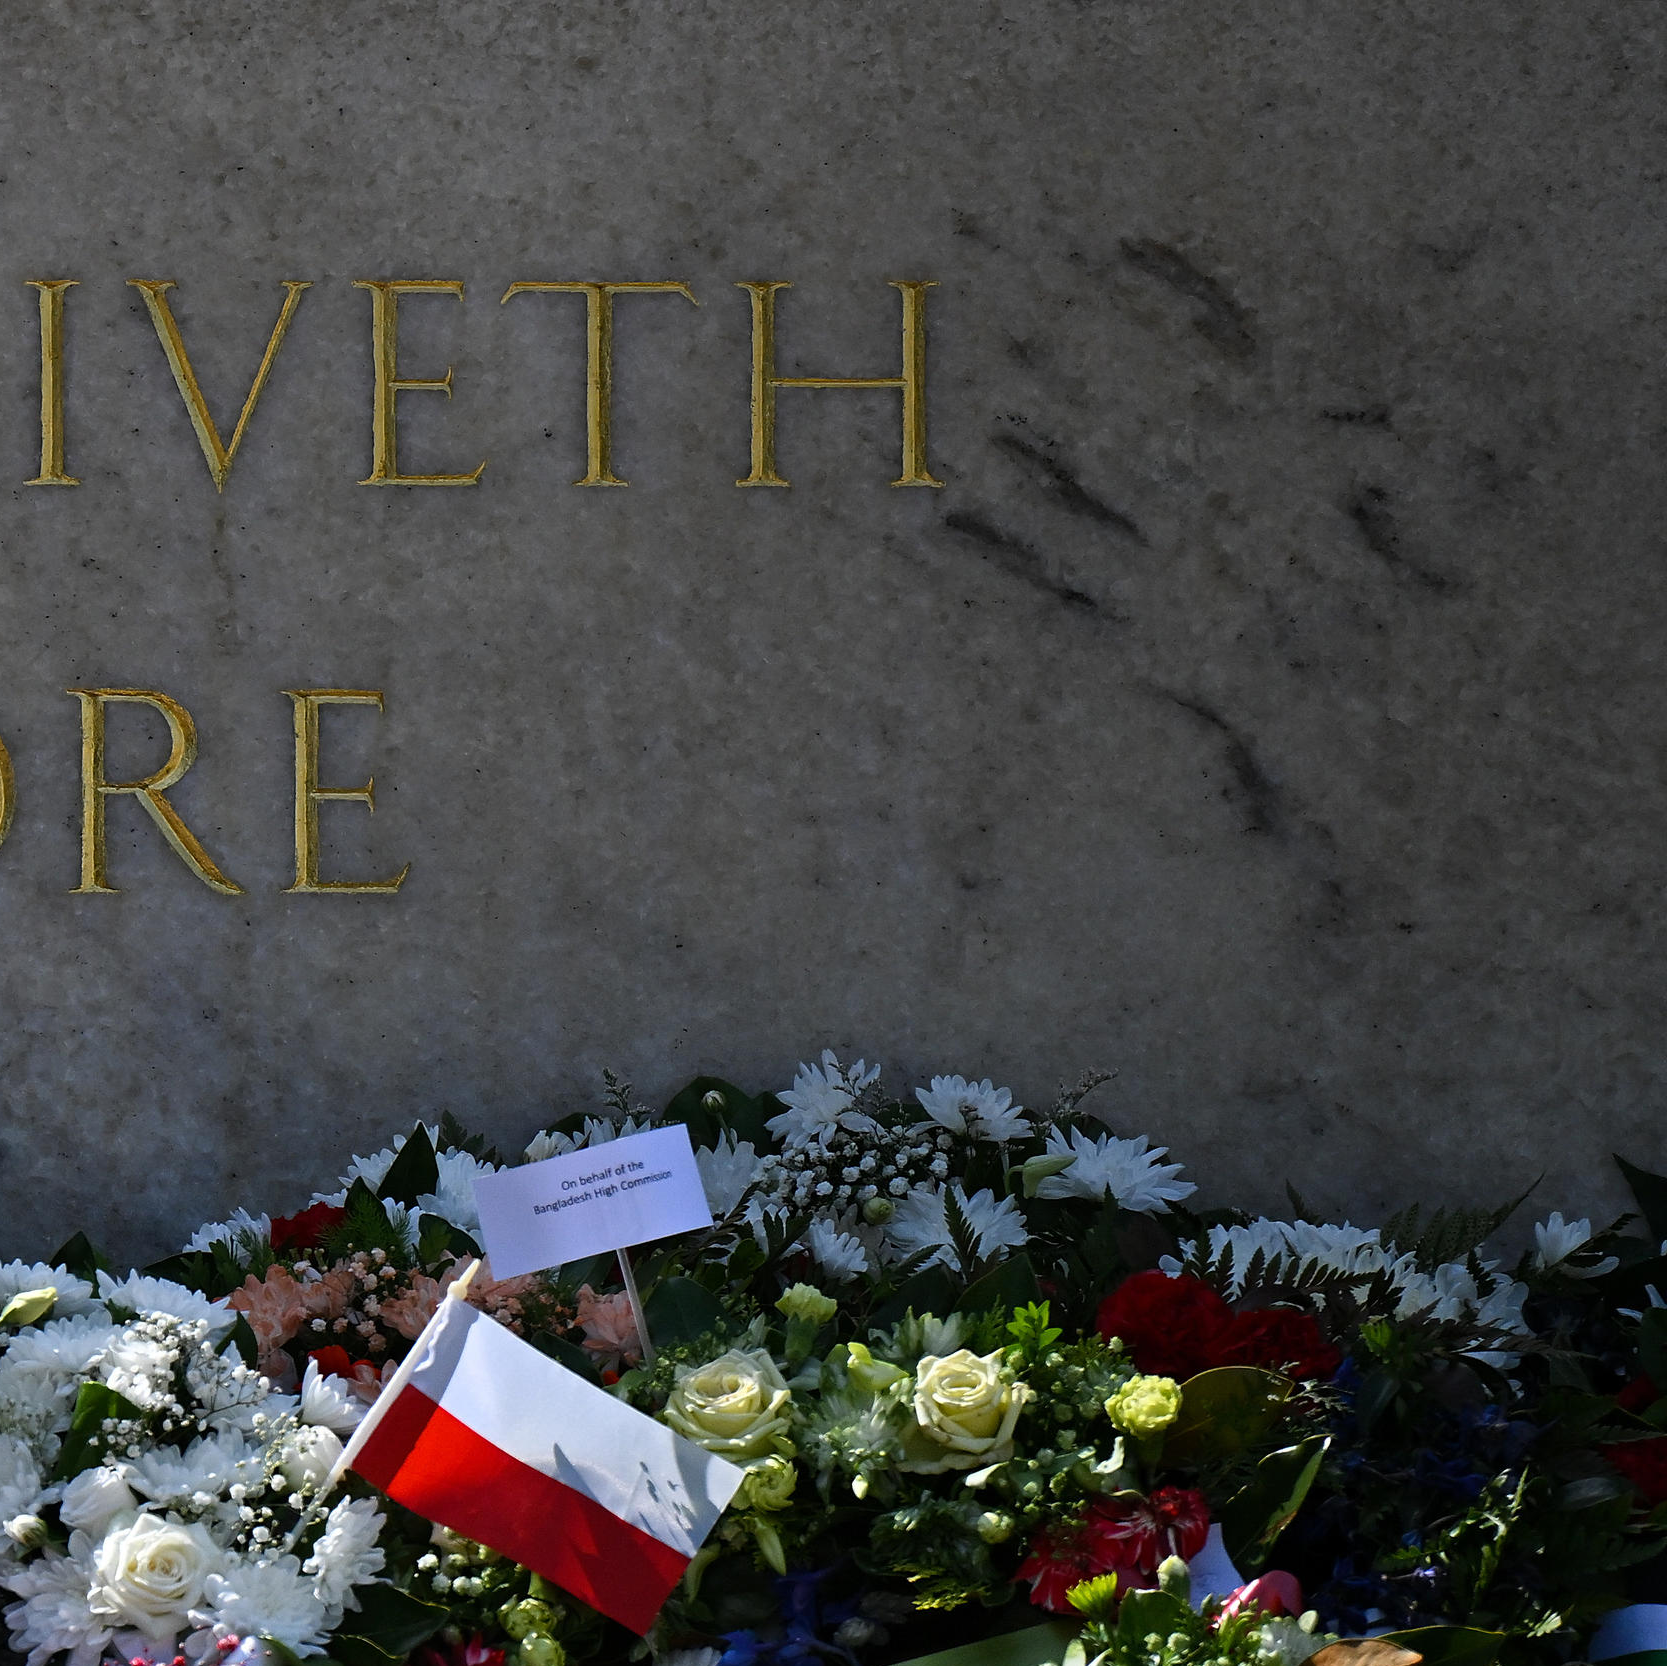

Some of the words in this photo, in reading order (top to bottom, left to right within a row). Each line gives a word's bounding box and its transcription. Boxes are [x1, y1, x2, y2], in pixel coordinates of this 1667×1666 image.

[533, 1191, 592, 1216] Bangladesh
[594, 1183, 618, 1201] High
[620, 1170, 673, 1191] Commission
[561, 1180, 576, 1191] On
[580, 1167, 613, 1186] behalf
[615, 1164, 626, 1175] of
[628, 1159, 644, 1171] the
